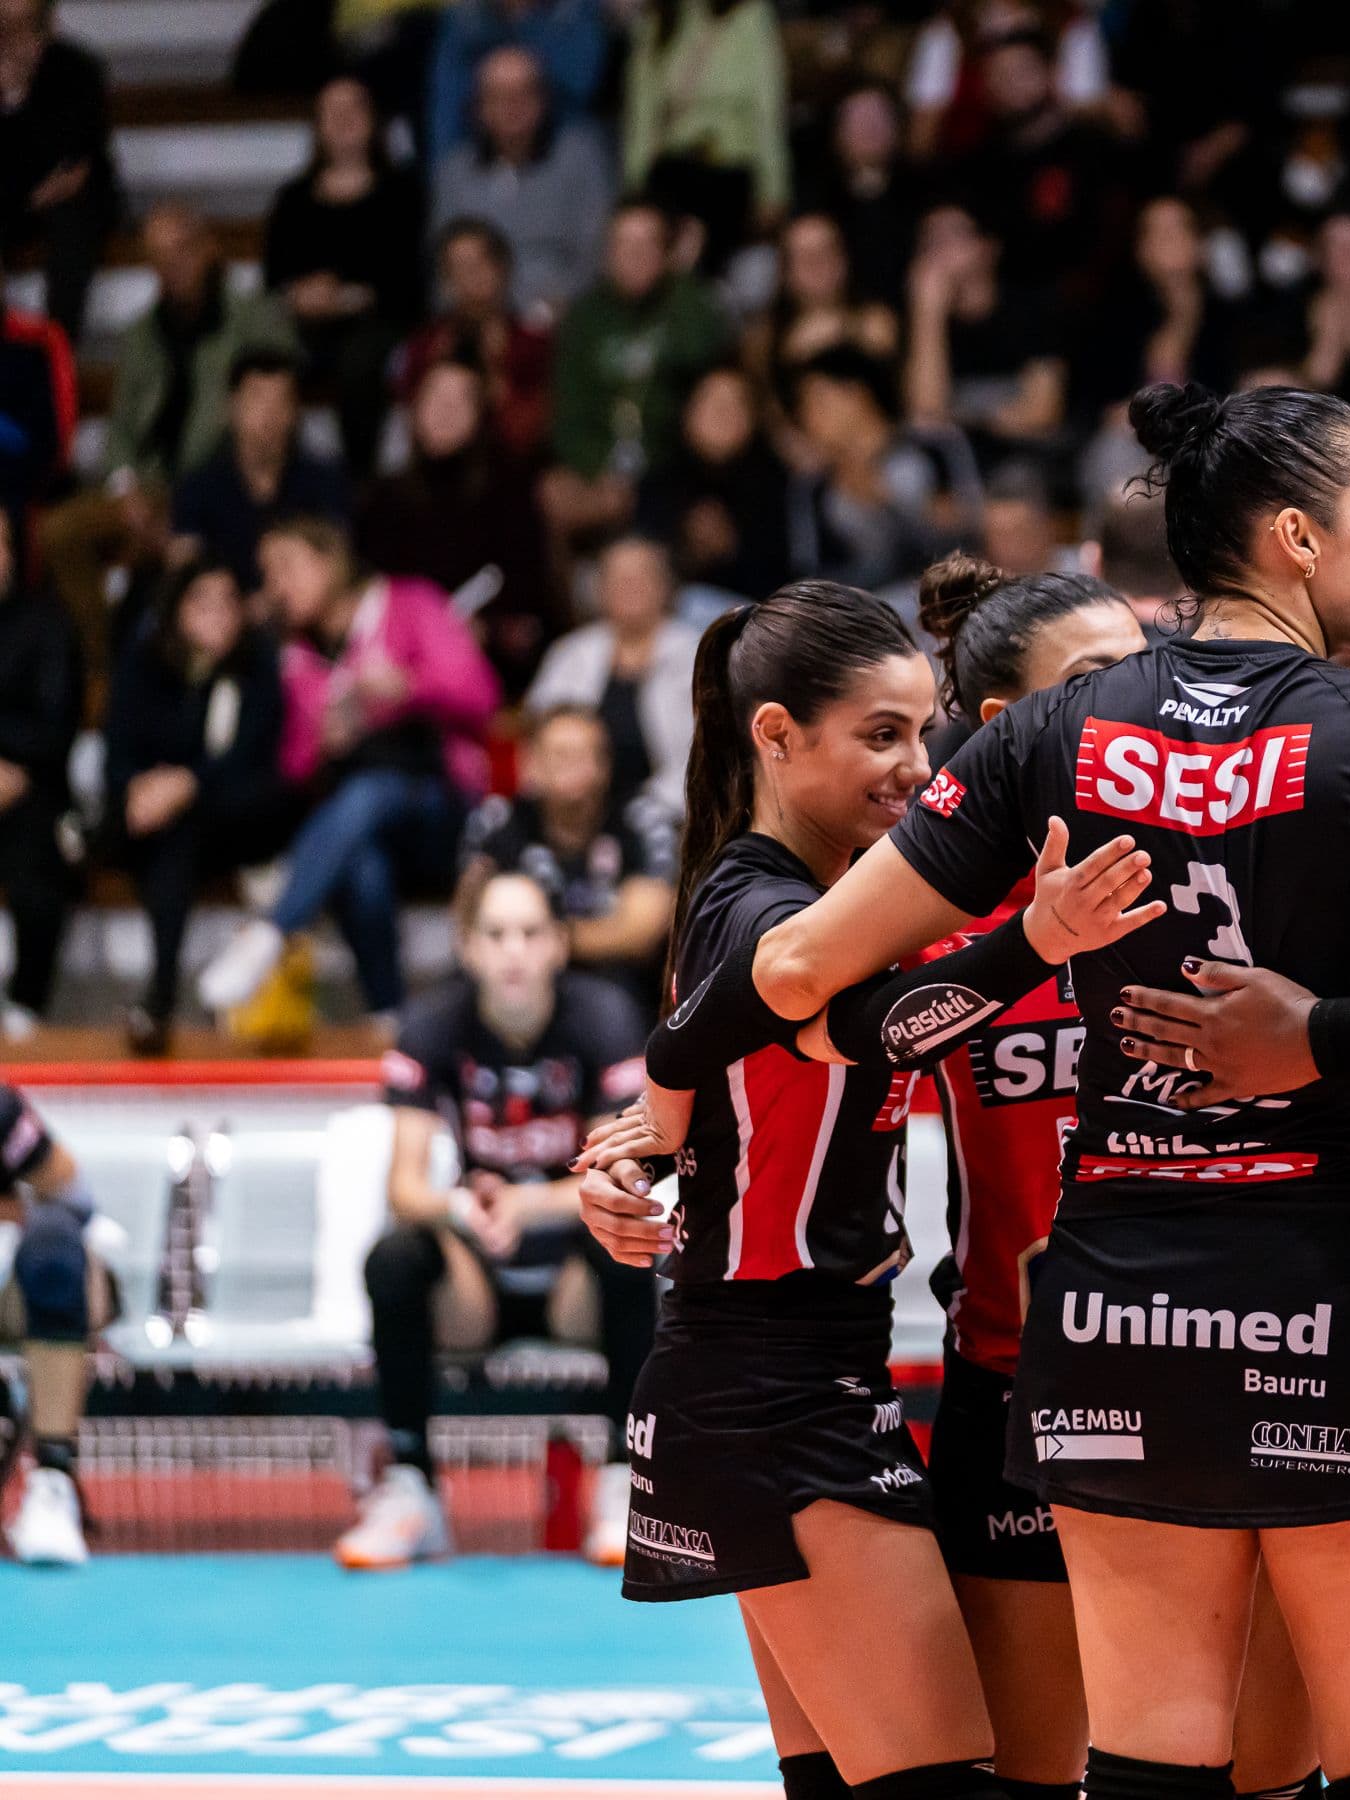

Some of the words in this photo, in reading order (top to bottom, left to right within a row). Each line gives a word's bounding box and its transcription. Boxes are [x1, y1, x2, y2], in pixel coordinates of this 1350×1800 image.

[1160, 699, 1249, 727] PENALTY
[1096, 735, 1286, 827] SESI
[888, 990, 975, 1046] Plasútil
[992, 1026, 1087, 1098] SE
[1062, 1291, 1333, 1356] Unimed
[1244, 1368, 1327, 1398] Bauru
[1031, 1408, 1143, 1432] CAEMBU
